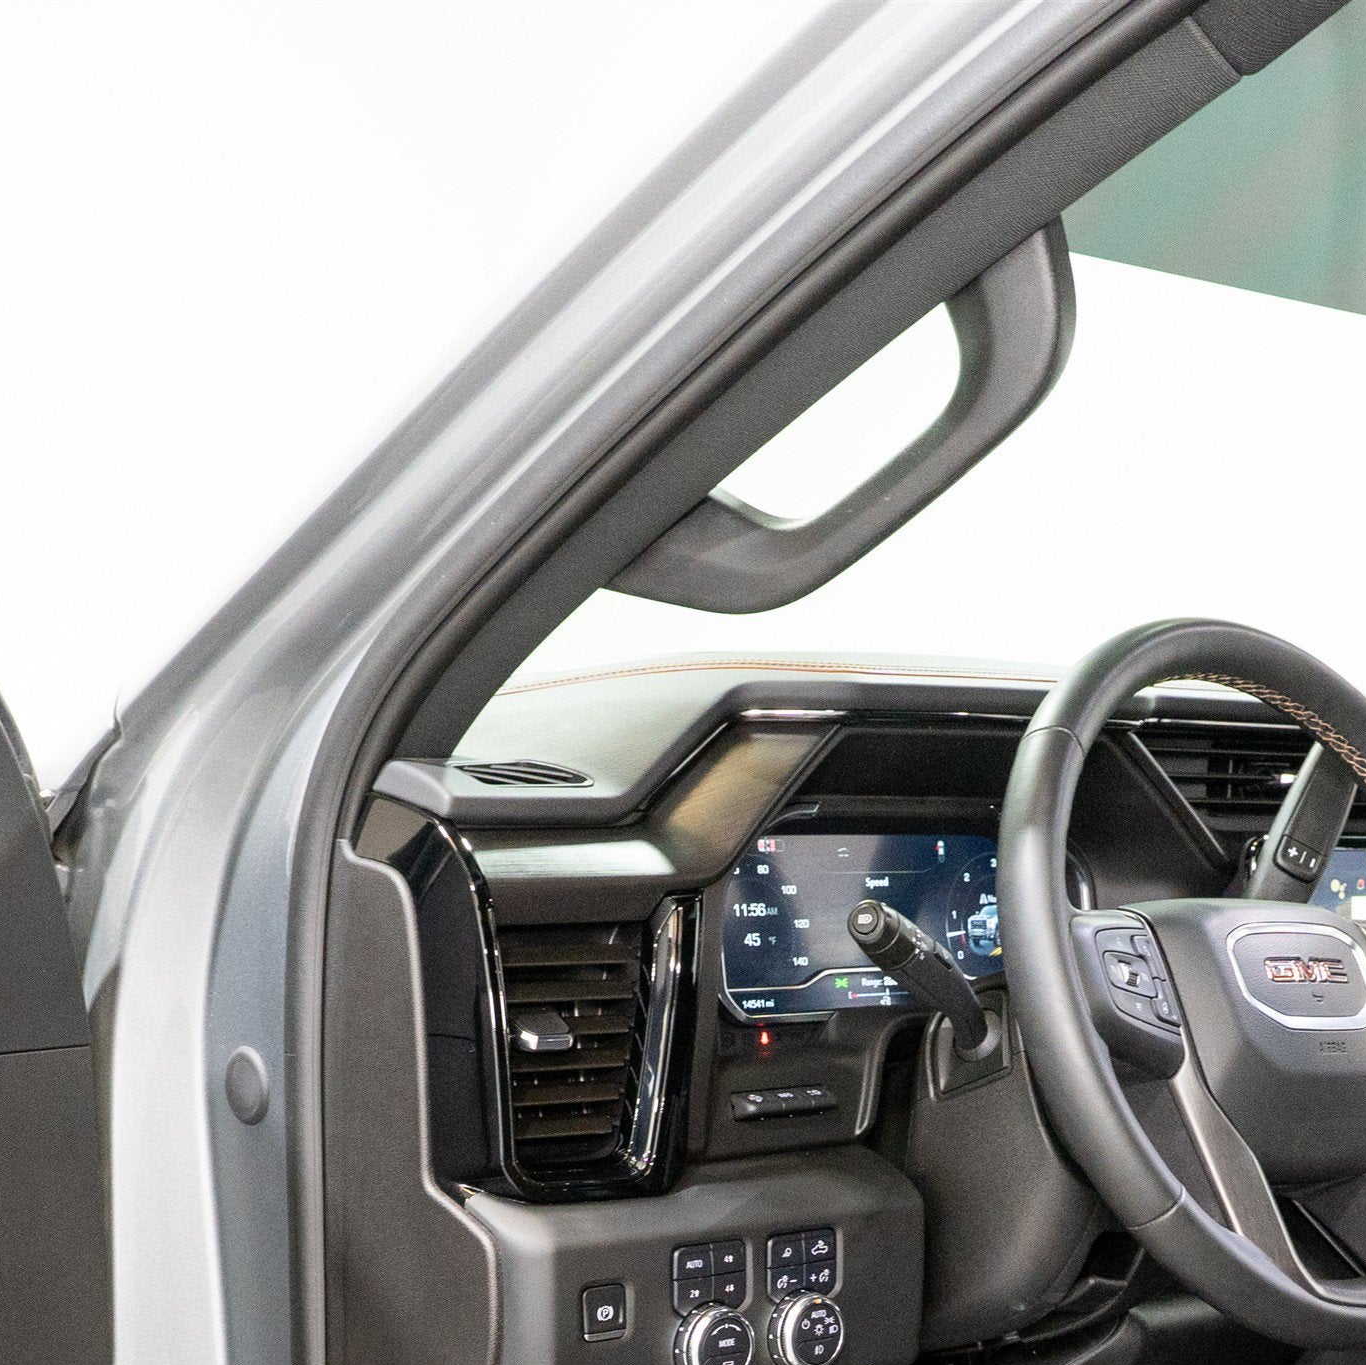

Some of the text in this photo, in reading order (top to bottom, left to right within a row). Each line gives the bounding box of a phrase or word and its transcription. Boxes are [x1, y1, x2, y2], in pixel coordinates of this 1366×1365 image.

[757, 864, 769, 875] 80
[963, 872, 970, 882] 2
[865, 876, 889, 889] Speed
[781, 885, 797, 895] 100
[733, 903, 767, 917] 11:56
[793, 919, 810, 929] 120
[743, 933, 761, 947] 45
[792, 957, 809, 967] 140
[1264, 957, 1349, 984] GMC
[686, 1260, 703, 1269] AUTO
[811, 1310, 826, 1319] AUTO
[718, 1338, 736, 1348] MODE
